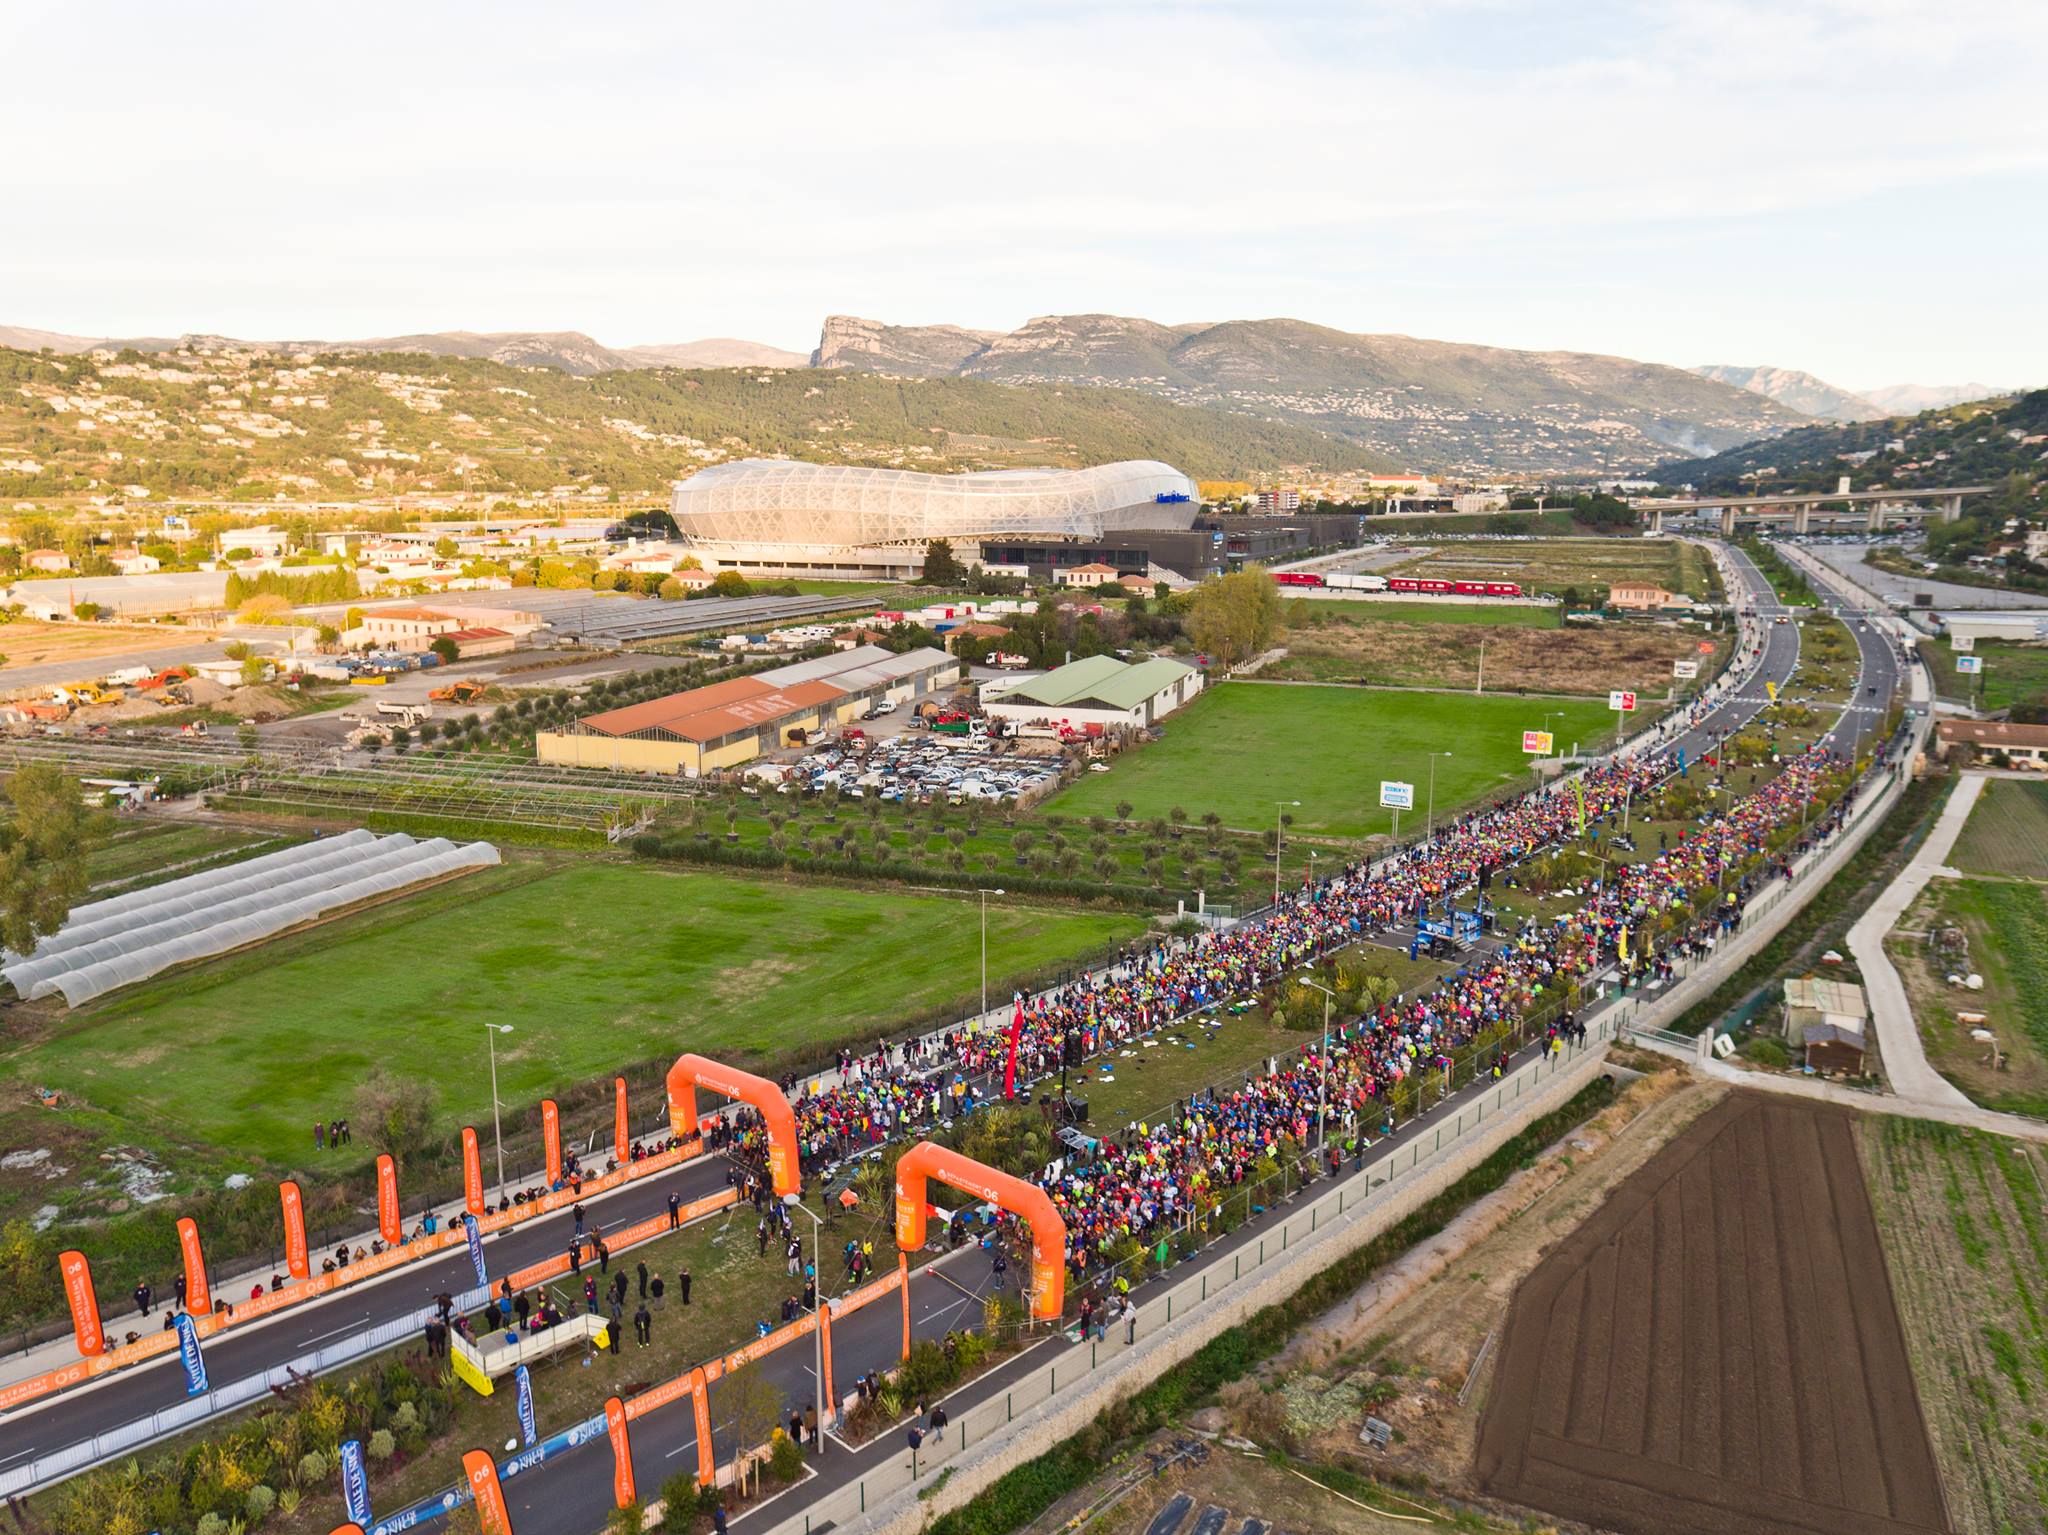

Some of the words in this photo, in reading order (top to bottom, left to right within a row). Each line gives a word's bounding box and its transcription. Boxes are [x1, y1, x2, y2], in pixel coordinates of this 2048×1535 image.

[983, 1187, 999, 1202] 06
[513, 1206, 532, 1220] 06
[413, 1239, 433, 1254] 06
[67, 1261, 82, 1275] 06
[306, 1279, 326, 1295] 06
[55, 1367, 81, 1385] 06
[188, 1357, 202, 1386] VILLE
[610, 1410, 622, 1428] 06
[351, 1471, 362, 1488] DE
[473, 1464, 490, 1484] 06
[353, 1486, 365, 1519] VILLE
